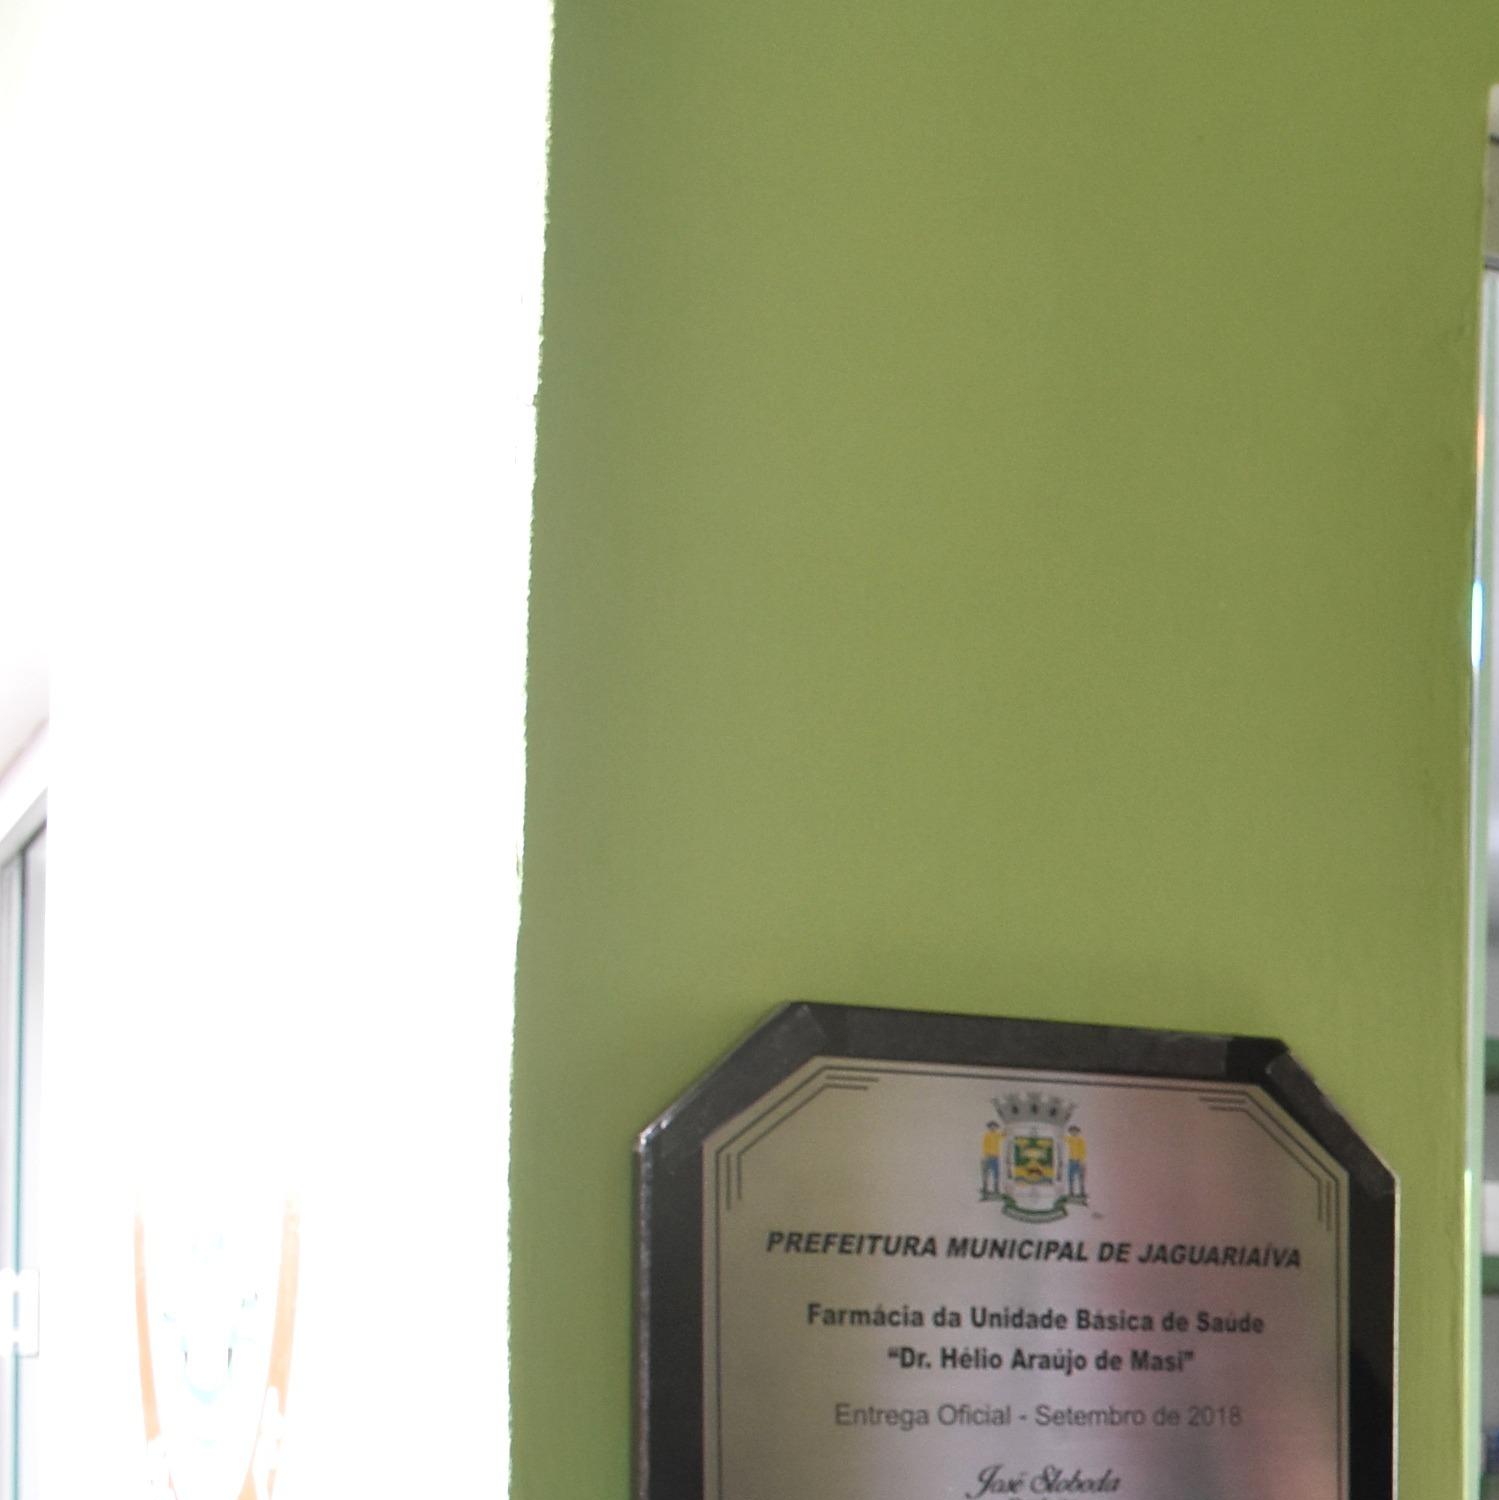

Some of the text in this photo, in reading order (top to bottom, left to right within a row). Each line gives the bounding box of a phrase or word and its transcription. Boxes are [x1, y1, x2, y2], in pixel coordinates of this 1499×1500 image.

[766, 1231, 1301, 1268] PREFEITURA MUNICIPAL DE JAGUARIAÍVA
[807, 1302, 1264, 1333] Farmácia da Unidade Básica de Saúde
[940, 1347, 1003, 1370] Hélio
[1011, 1348, 1087, 1376] Araújo
[1094, 1350, 1123, 1371] de
[835, 1402, 929, 1431] Entrega
[938, 1403, 1011, 1427] Oficial
[1035, 1405, 1146, 1427] Setembro
[1152, 1405, 1180, 1427] de
[1187, 1404, 1243, 1427] 2018
[965, 1464, 1026, 1500] José
